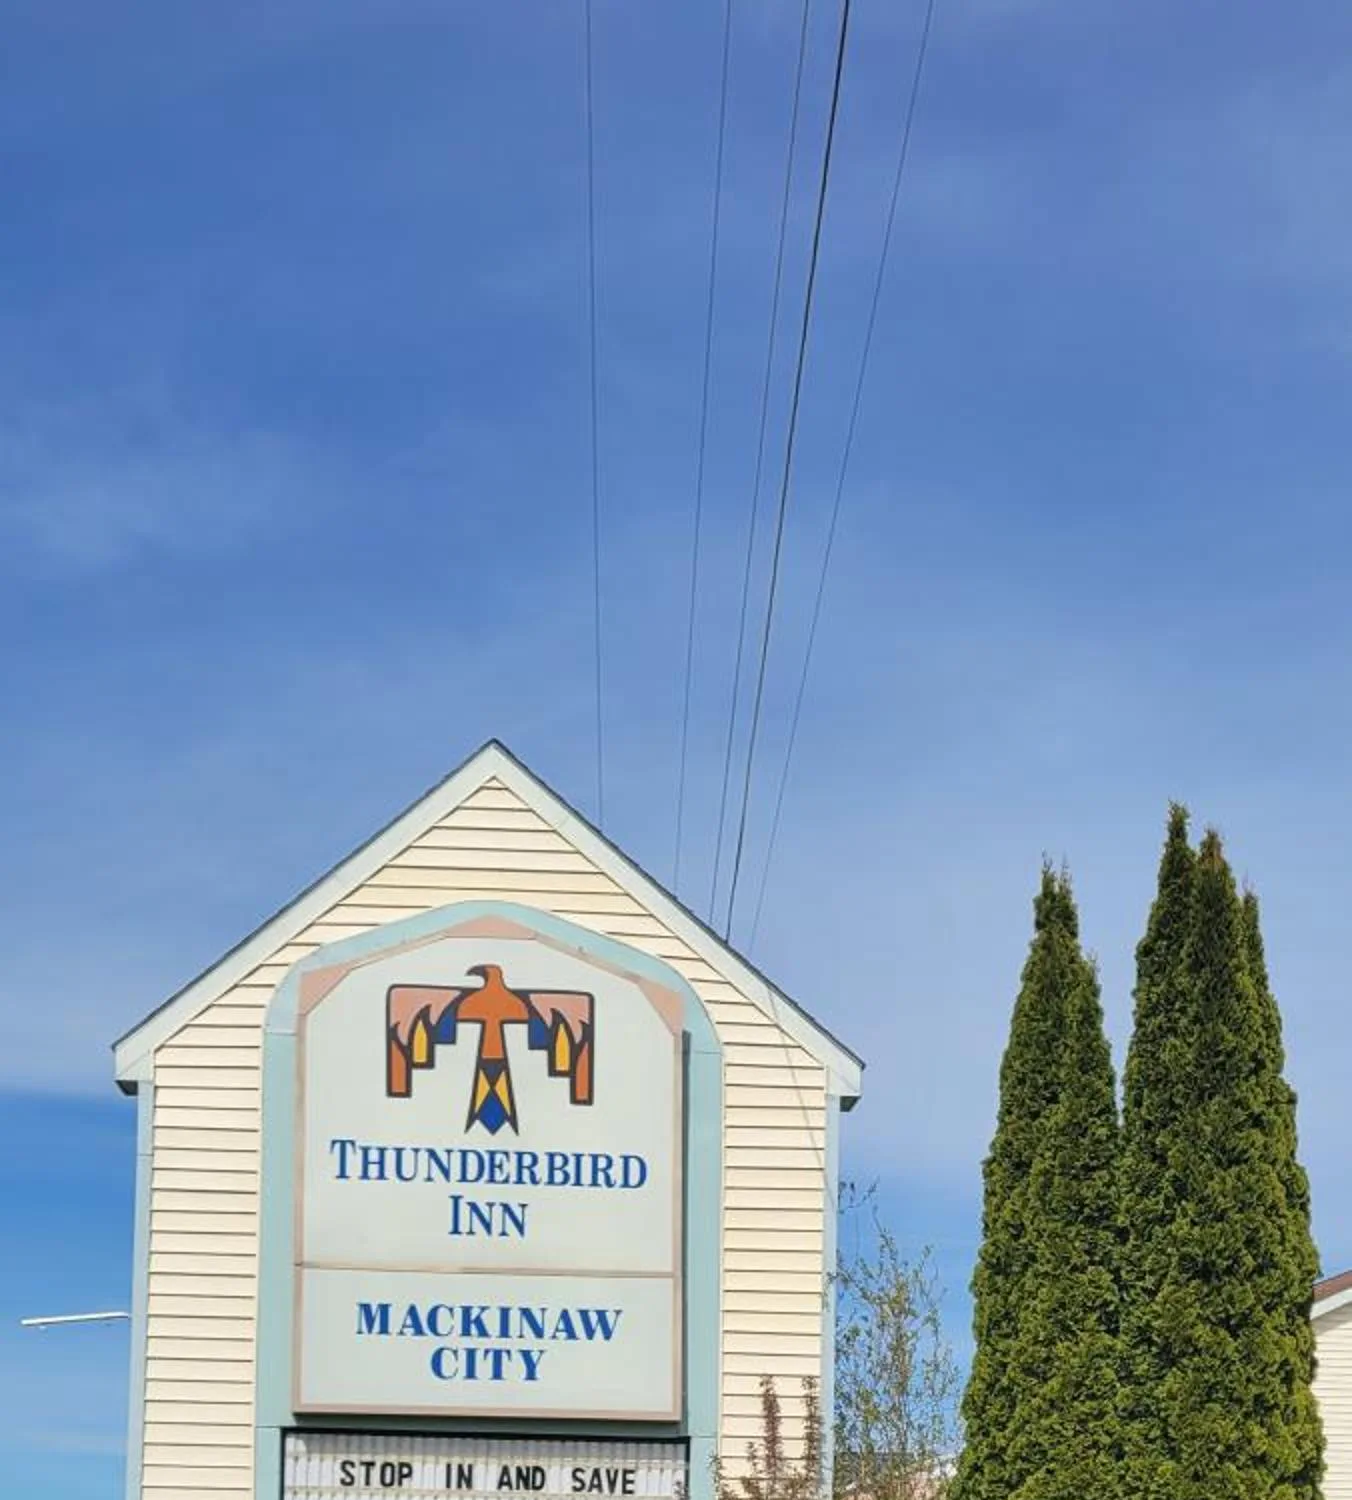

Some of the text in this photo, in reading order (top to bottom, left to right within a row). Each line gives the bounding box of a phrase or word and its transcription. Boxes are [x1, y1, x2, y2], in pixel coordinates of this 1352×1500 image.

[330, 1139, 647, 1189] THUNDERBIRD
[448, 1195, 528, 1238] INN
[355, 1303, 622, 1340] MACKINAW
[431, 1347, 547, 1381] CITY
[339, 1460, 636, 1495] STOP IN AND SAVE
